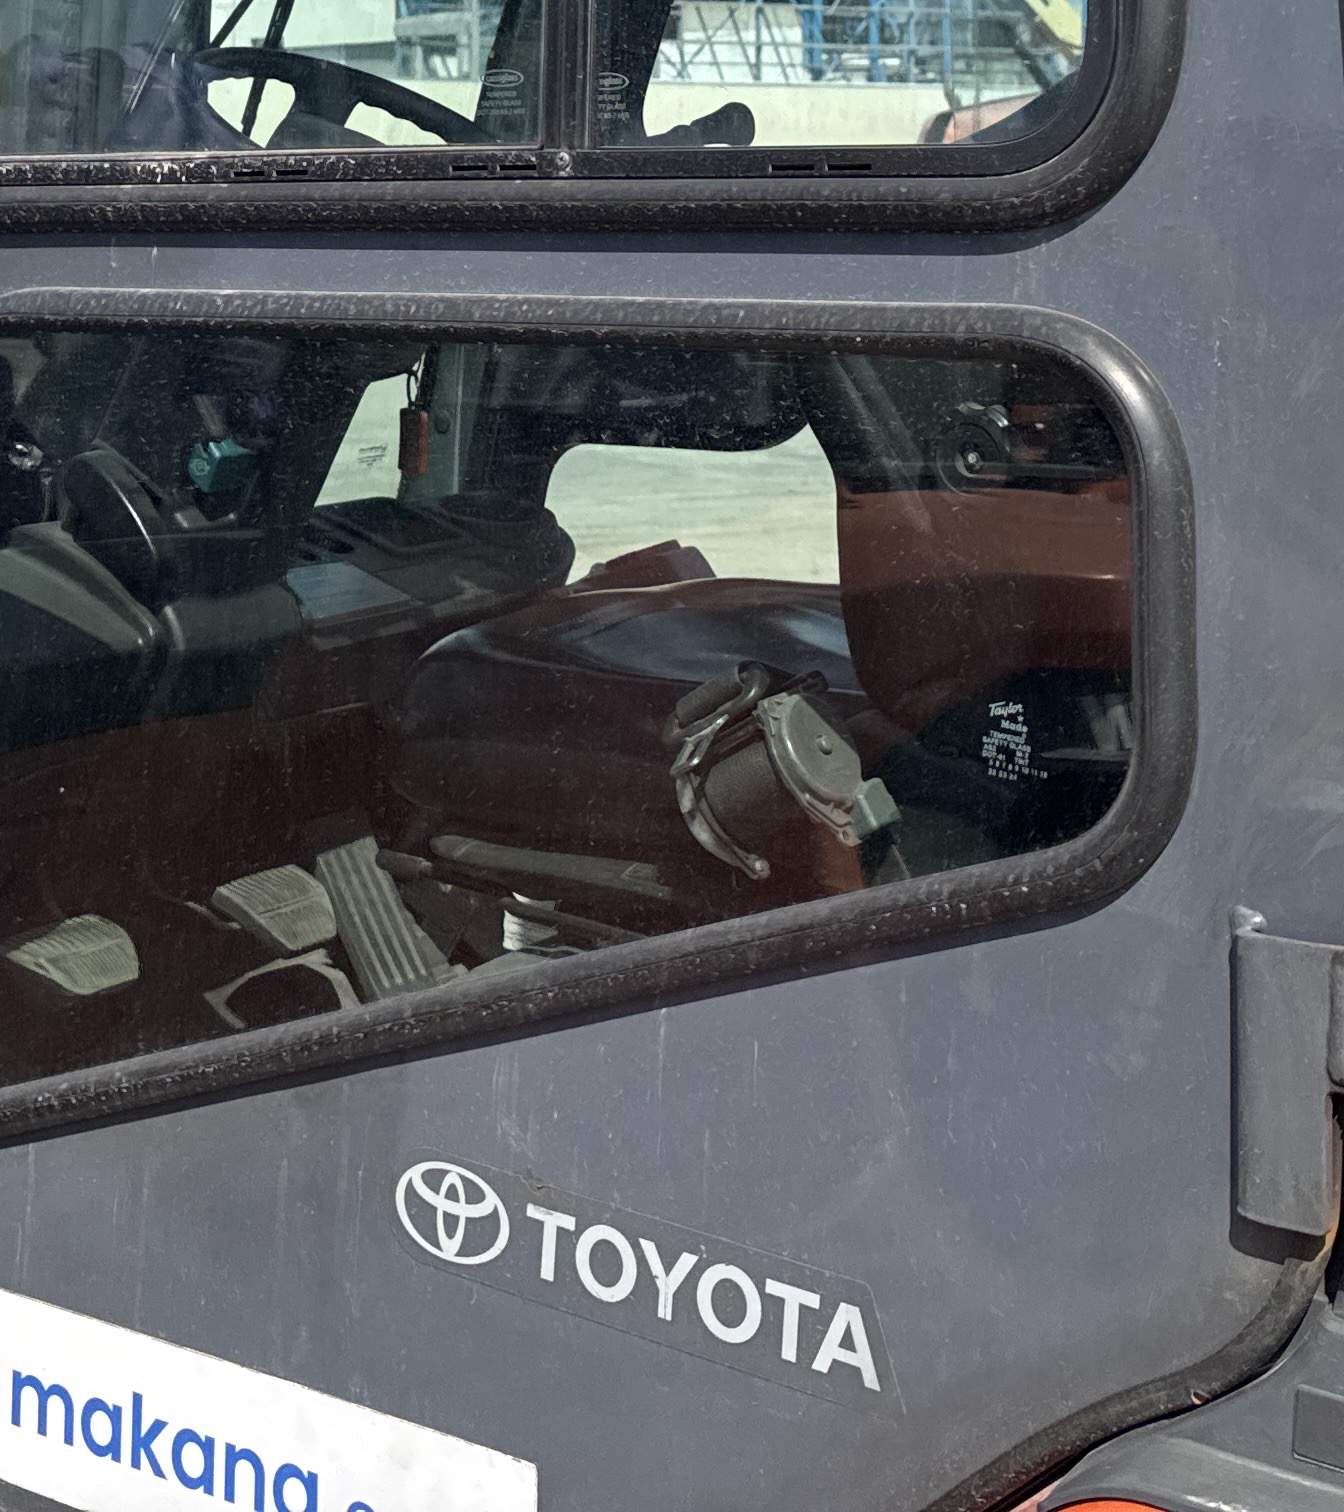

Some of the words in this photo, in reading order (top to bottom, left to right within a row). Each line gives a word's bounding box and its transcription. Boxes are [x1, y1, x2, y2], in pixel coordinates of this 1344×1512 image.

[988, 701, 1024, 717] Taylor
[1001, 719, 1028, 733] Made
[982, 736, 1008, 747] SAFETY
[1008, 741, 1032, 753] GLASS
[526, 1203, 882, 1391] TOYOTA
